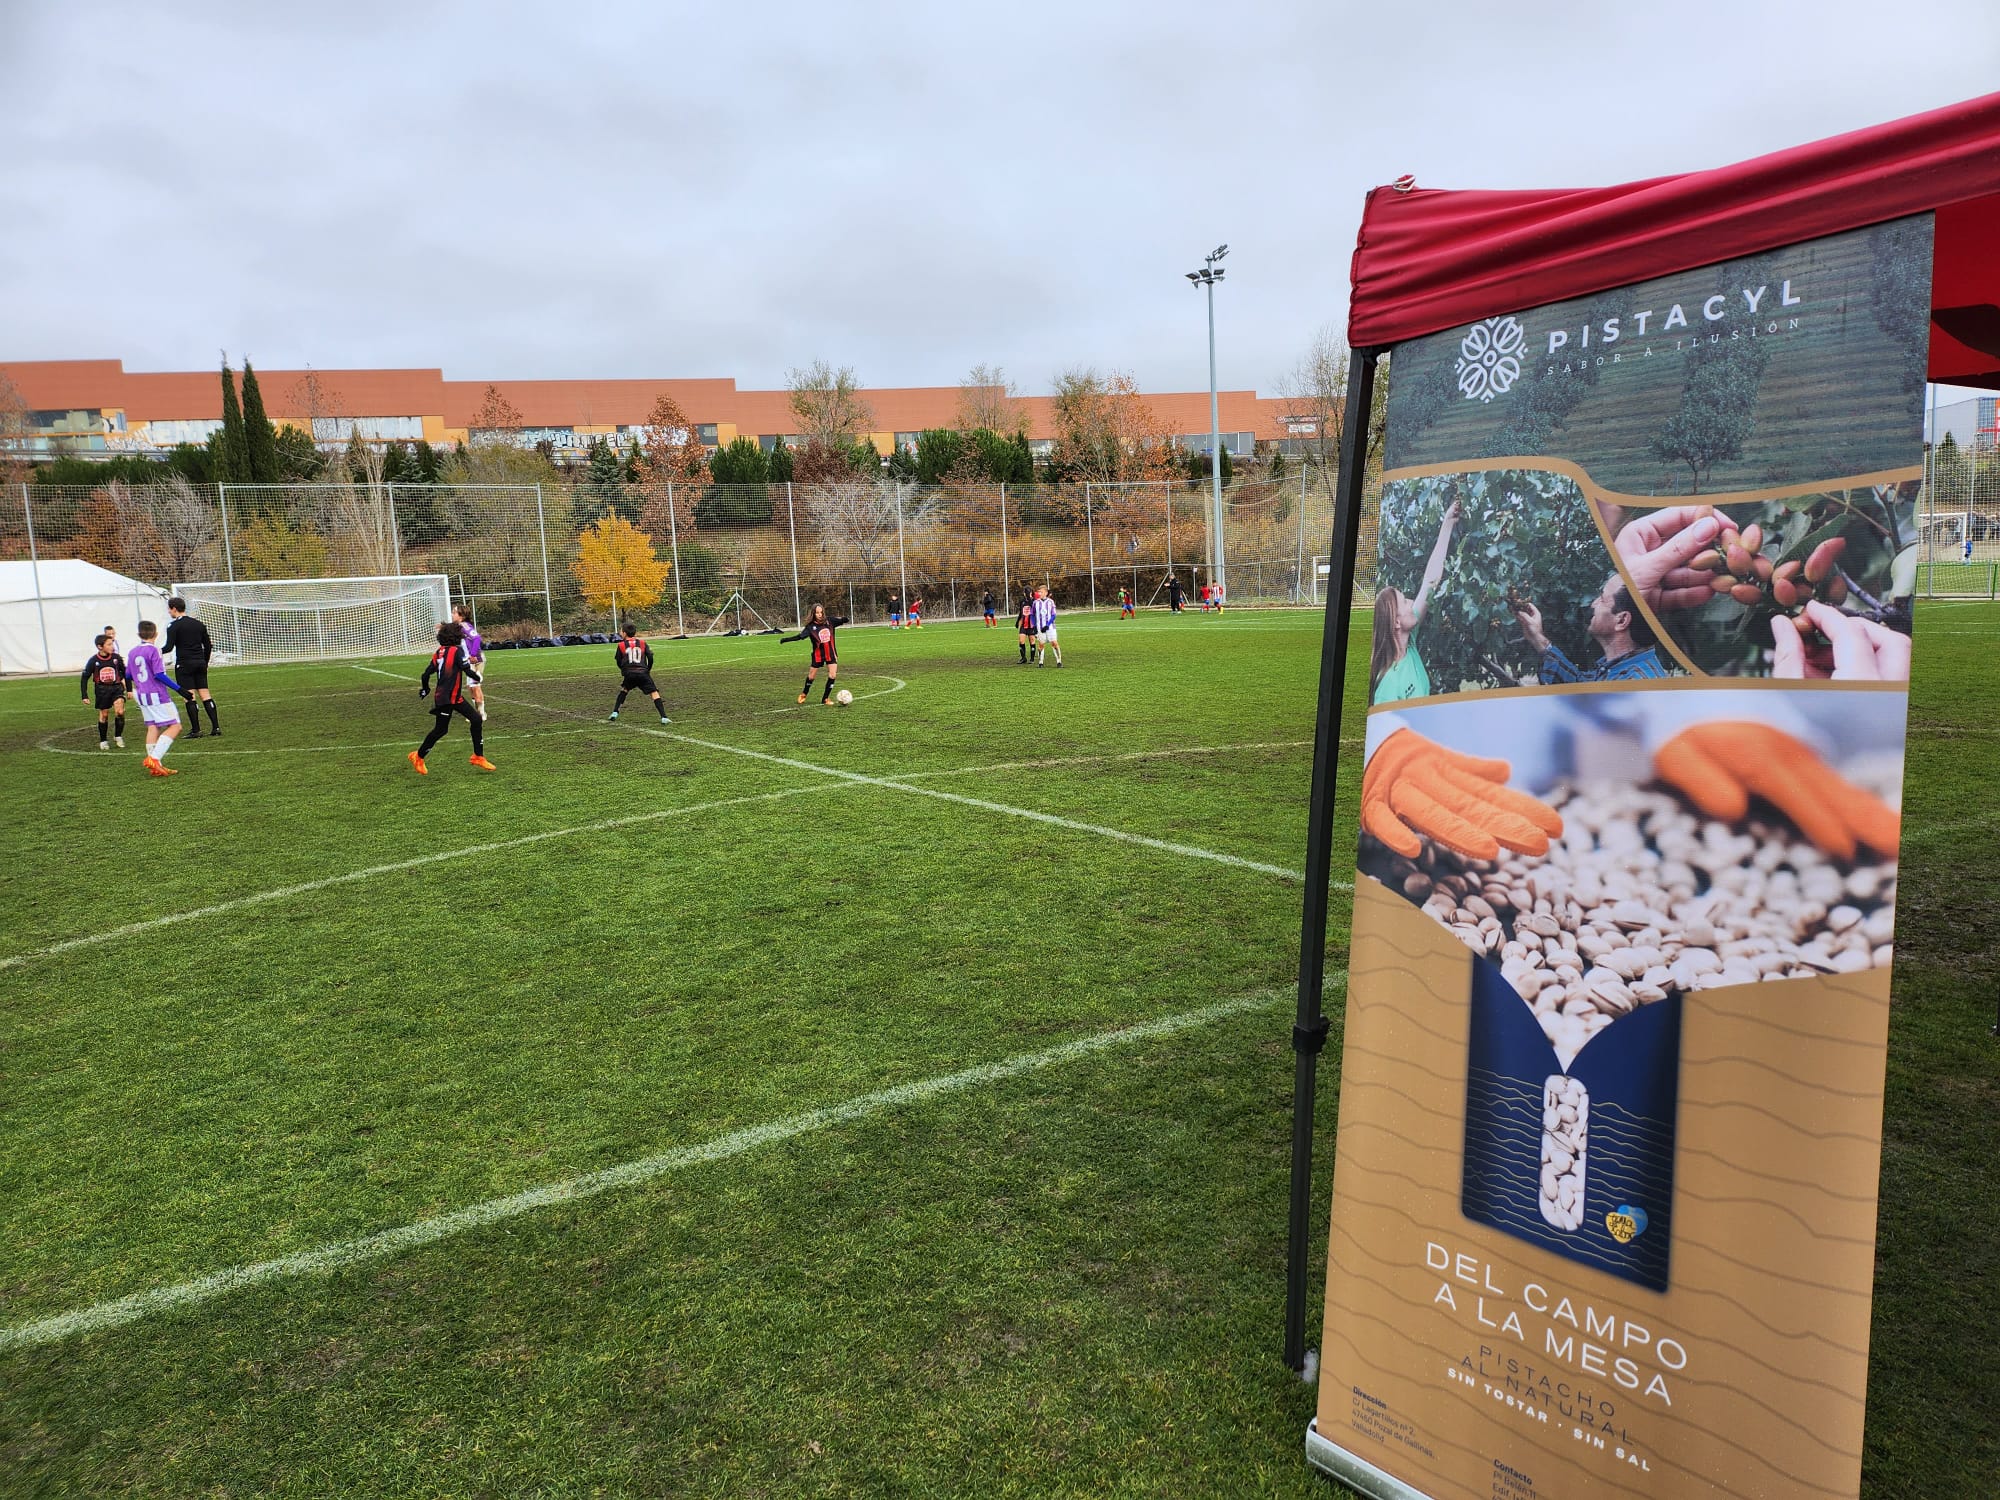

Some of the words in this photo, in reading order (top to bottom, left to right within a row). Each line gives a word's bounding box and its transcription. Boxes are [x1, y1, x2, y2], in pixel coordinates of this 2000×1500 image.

[1546, 353, 1622, 376] SABOR
[1644, 347, 1653, 358] A
[1676, 317, 1800, 352] ILUSIÓN
[1549, 280, 1800, 353] PISTACYL
[134, 655, 149, 684] 3
[625, 646, 642, 664] 10
[1426, 1241, 1504, 1295] DEL
[1523, 1283, 1687, 1370] CAMPO
[1434, 1282, 1457, 1311] A
[1477, 1296, 1525, 1341] LA
[1545, 1327, 1672, 1407] MESA
[1479, 1344, 1616, 1417] PISTACHO
[1447, 1366, 1475, 1388] SIN
[1484, 1383, 1549, 1424] TOSTAR
[1572, 1427, 1605, 1450] SIN
[1615, 1446, 1651, 1473] SAL
[1461, 1355, 1490, 1378] AL
[1506, 1374, 1635, 1447] NATURAL
